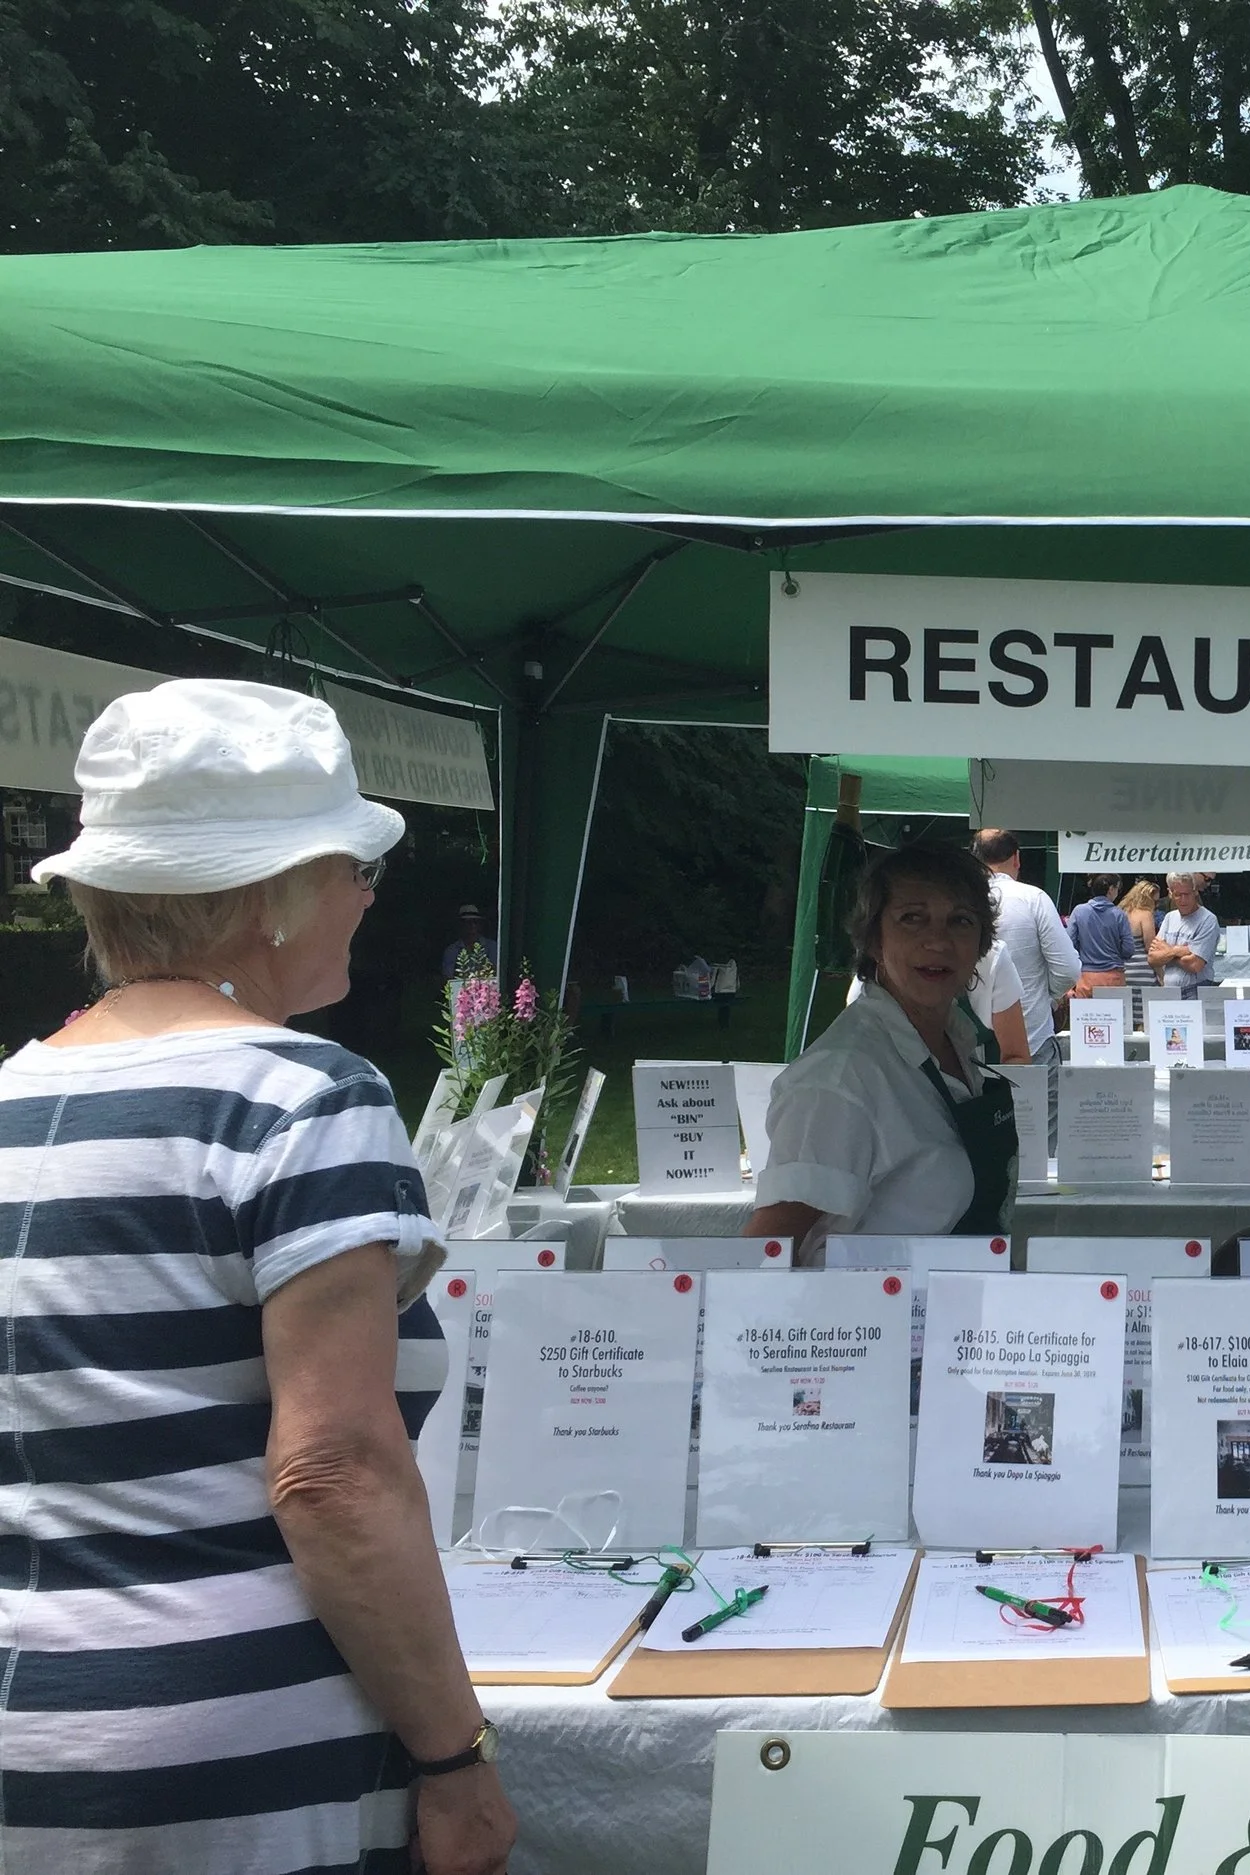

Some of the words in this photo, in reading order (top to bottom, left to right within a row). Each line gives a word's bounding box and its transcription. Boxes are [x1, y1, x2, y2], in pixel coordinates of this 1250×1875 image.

[660, 1080, 710, 1090] NEW!!!!!
[658, 1098, 678, 1108] Ask
[682, 1098, 716, 1108] about
[684, 1150, 694, 1160] IT
[788, 1328, 808, 1342] Gift
[810, 1326, 834, 1342] Card
[838, 1326, 852, 1340] for
[854, 1326, 882, 1342] $100
[1006, 1330, 1024, 1344] Gift
[1028, 1332, 1078, 1346] Certificate
[1082, 1332, 1096, 1346] for
[540, 1346, 566, 1362] $250
[570, 1346, 588, 1360] Gift
[592, 1346, 644, 1360] Certificate
[750, 1348, 760, 1360] to
[762, 1344, 808, 1360] Serafina
[810, 1344, 868, 1358] Restaurant
[956, 1346, 982, 1362] $100
[986, 1350, 996, 1360] to
[998, 1348, 1026, 1364] Dopo
[1028, 1348, 1042, 1362] La
[1044, 1350, 1090, 1366] Spiaggia
[1208, 1356, 1218, 1368] to
[1222, 1354, 1248, 1368] Elaia
[558, 1366, 568, 1378] to
[572, 1364, 622, 1378] Starbucks
[552, 1426, 574, 1436] Thank
[574, 1430, 586, 1438] you
[588, 1426, 620, 1436] Starbucks
[758, 1420, 778, 1432] Thank
[778, 1424, 792, 1432] you
[792, 1420, 820, 1430] Serafina
[820, 1420, 856, 1430] Restaurant
[972, 1468, 992, 1478] Thank
[992, 1472, 1006, 1480] you
[1006, 1470, 1024, 1480] Dopo
[1024, 1470, 1032, 1480] La
[1034, 1470, 1062, 1482] Spiaggia
[1216, 1504, 1234, 1514] Thank
[1236, 1508, 1250, 1516] you
[893, 1795, 1186, 1875] Food
